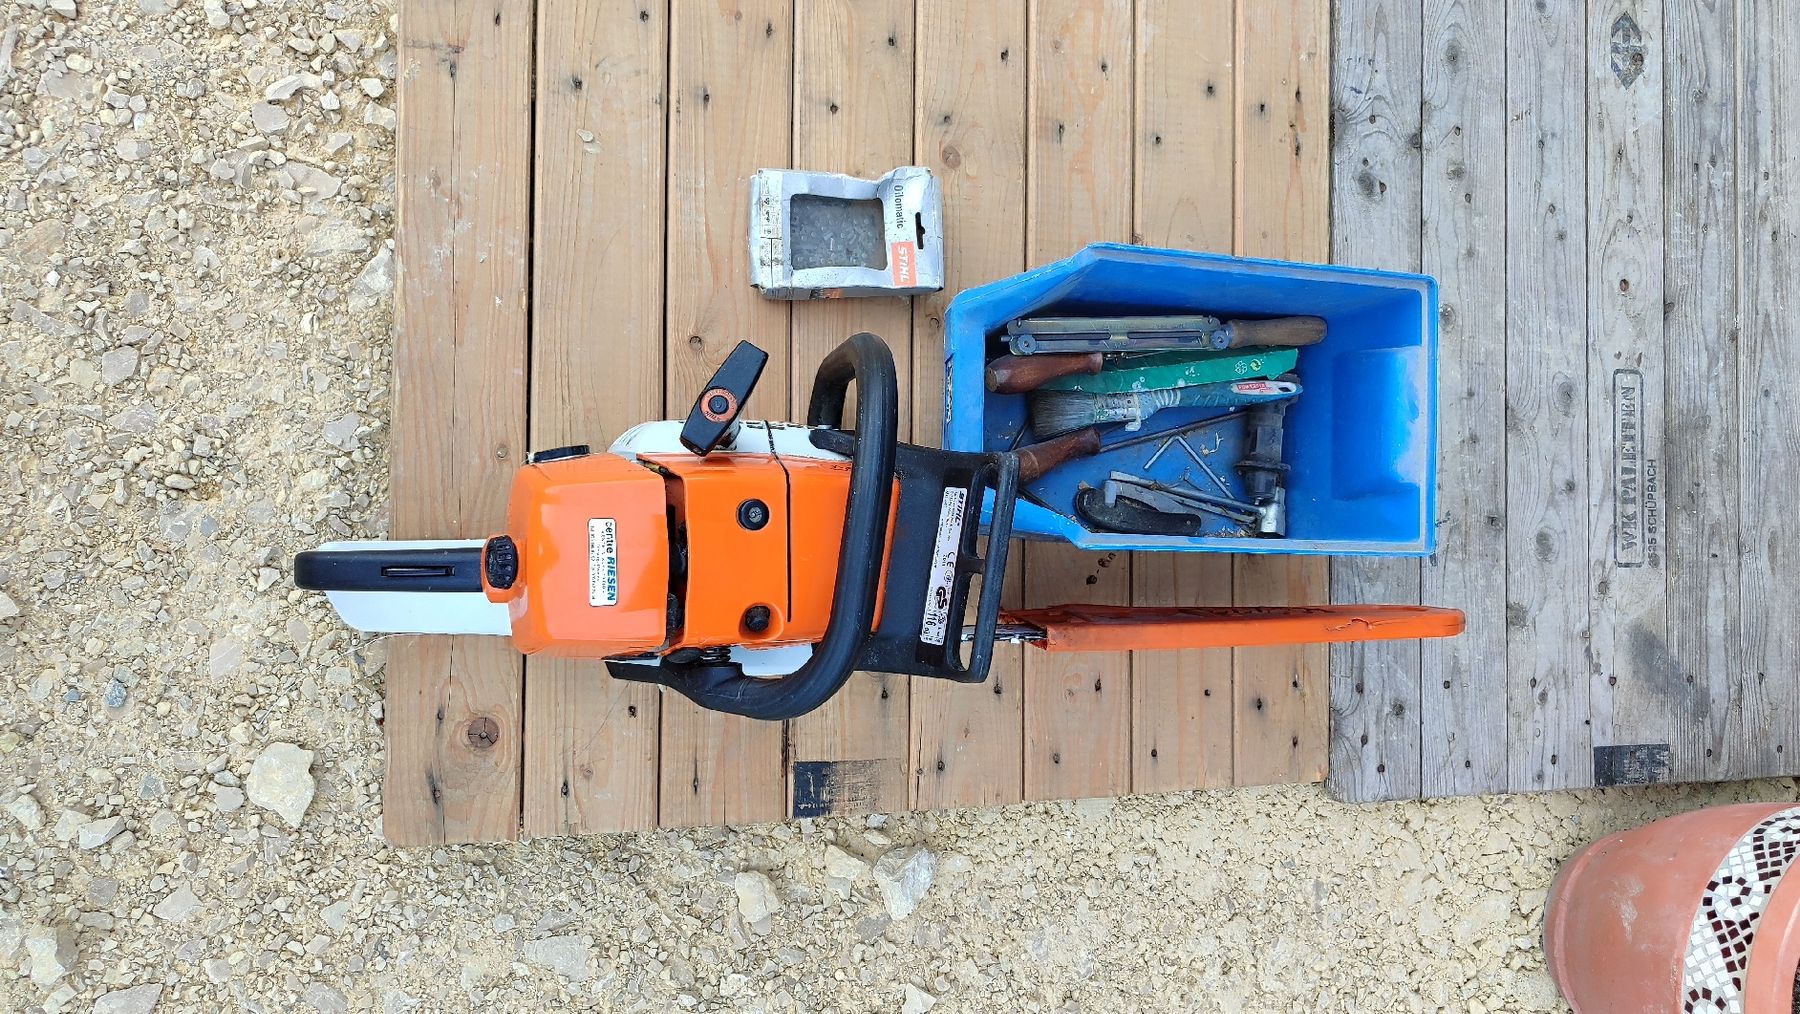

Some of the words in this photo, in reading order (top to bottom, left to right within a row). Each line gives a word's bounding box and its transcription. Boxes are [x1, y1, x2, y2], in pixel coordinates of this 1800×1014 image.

[893, 184, 906, 229] Oilomatic
[897, 246, 910, 283] STIHL
[1620, 385, 1636, 505] PALETTEN
[954, 490, 965, 524] STIHL
[1645, 459, 1657, 534] SCHÜPBACH
[1620, 510, 1637, 552] WK
[1648, 538, 1658, 566] 525
[607, 556, 616, 601] RIESEN
